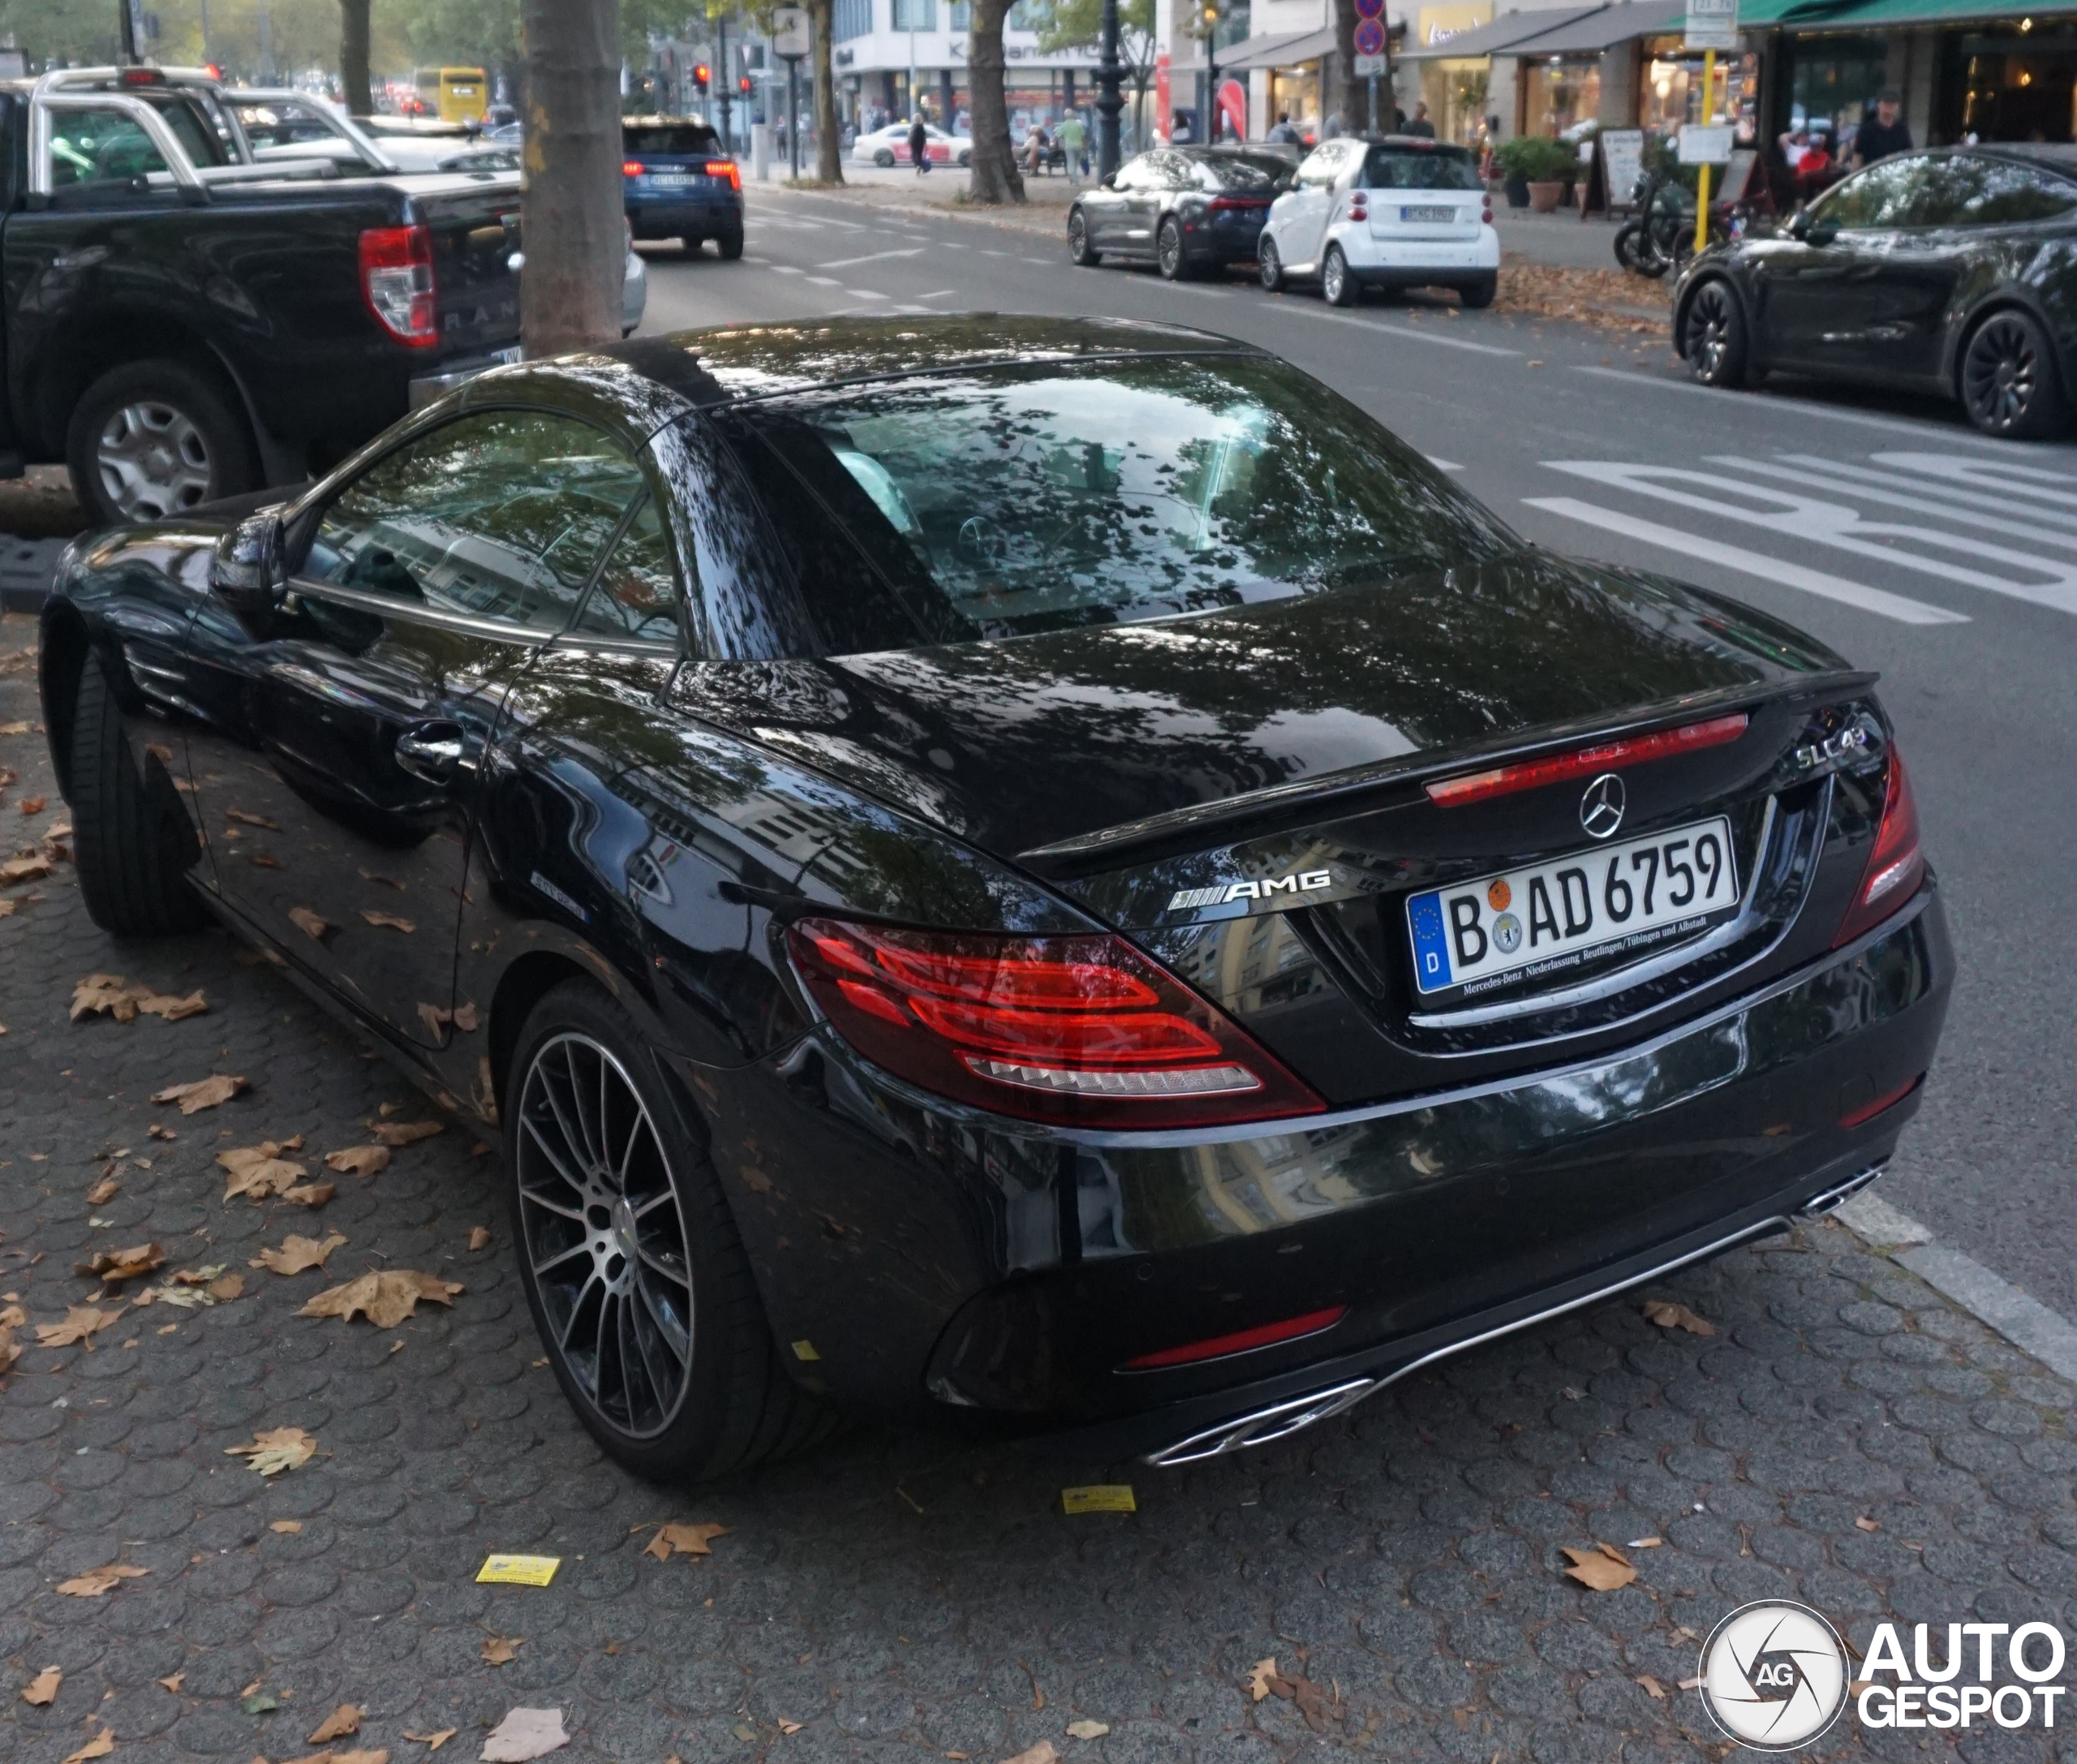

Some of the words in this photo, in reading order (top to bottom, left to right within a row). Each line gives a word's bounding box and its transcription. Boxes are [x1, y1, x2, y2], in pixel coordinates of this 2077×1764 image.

[1222, 869, 1331, 903] AMG
[1426, 951, 1439, 973] D
[1448, 894, 1488, 967] B
[1529, 867, 1593, 948] AD
[1604, 833, 1722, 924] 6759
[1463, 970, 1523, 996] Mercedes-Benz
[1525, 953, 1580, 978] Niederlassung
[1583, 930, 1661, 961] Reutlingen/Tübingen
[1662, 923, 1676, 937] und
[1677, 915, 1707, 934] Albstadt
